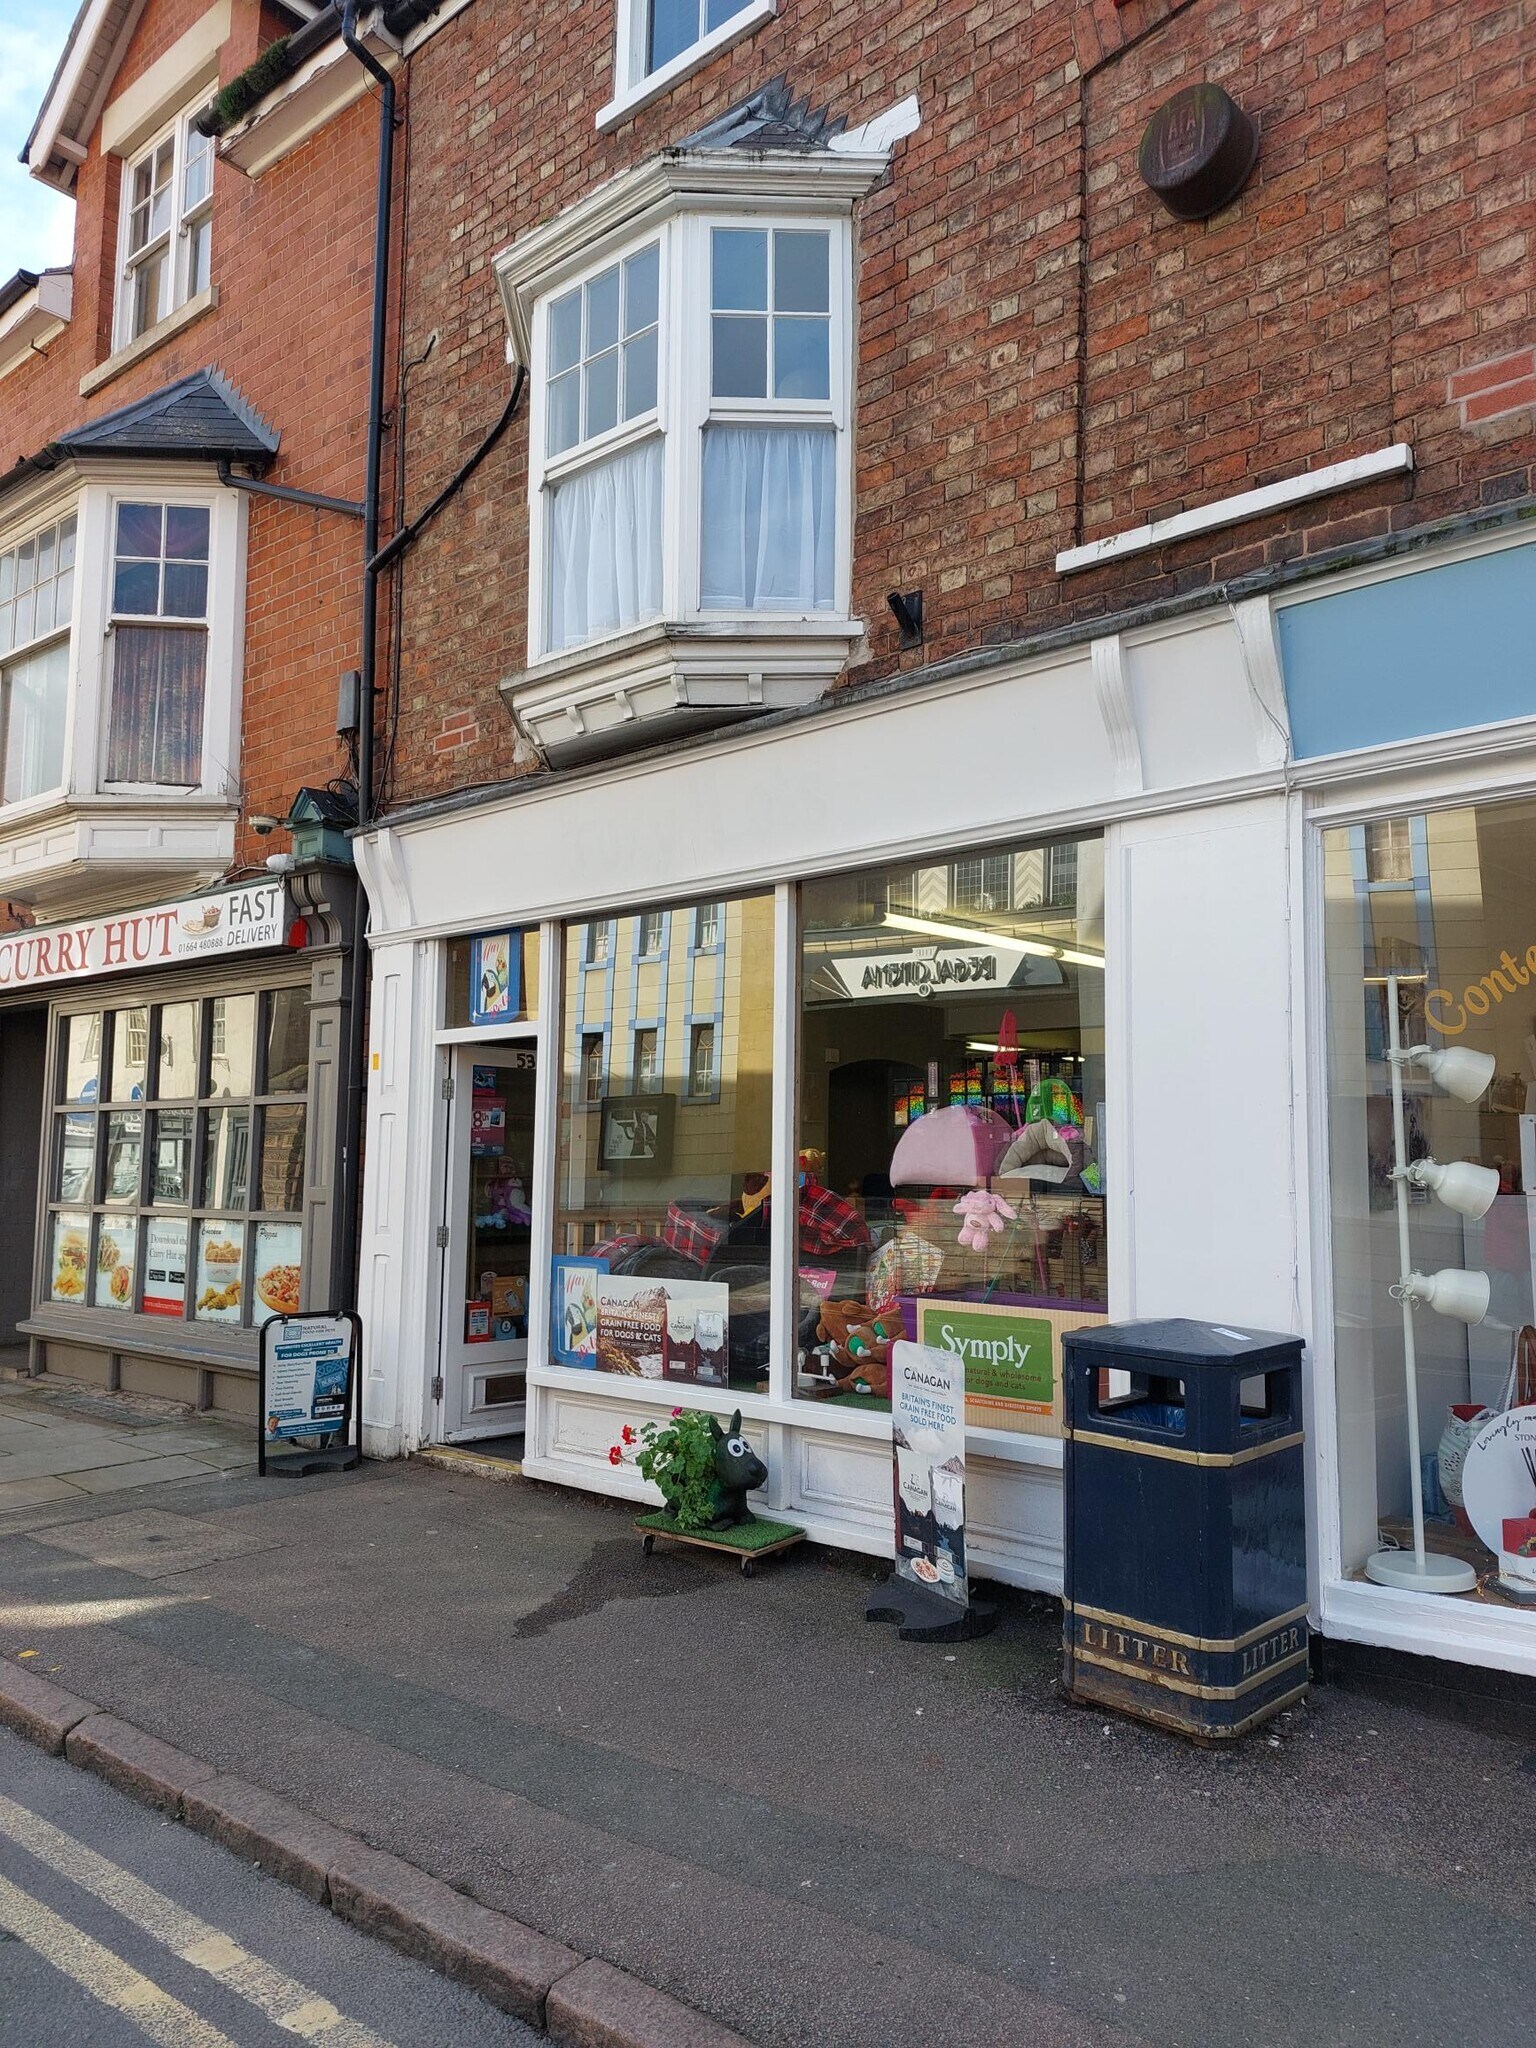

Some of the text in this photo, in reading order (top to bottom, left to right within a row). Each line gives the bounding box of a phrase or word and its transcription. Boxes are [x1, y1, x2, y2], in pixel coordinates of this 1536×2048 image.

[229, 888, 279, 925] FAST
[227, 923, 278, 946] DELIVERY
[0, 909, 178, 983] CURRY HUT
[178, 941, 198, 953] 01664
[516, 1052, 536, 1069] 53
[150, 1233, 178, 1245] Download
[149, 1248, 165, 1261] Curry
[166, 1250, 177, 1259] Hut
[811, 1280, 828, 1289] Red
[600, 1296, 640, 1309] CANAGAN
[600, 1309, 656, 1320] BRITAIN'S FINEST
[600, 1318, 660, 1331] GRAIN FREE FOOD
[600, 1328, 661, 1342] FOR DOGS & CATS
[941, 1324, 1032, 1368] Symply
[904, 1367, 950, 1390] CANAGAN
[965, 1367, 1042, 1382] natural & wholesome
[975, 1377, 993, 1388] dogs
[1010, 1382, 1026, 1390] cats
[901, 1392, 954, 1414] BRITAIN'S FINEST
[900, 1402, 957, 1425] GRAIN FREE FOOD
[910, 1414, 945, 1432] SOLD HERE
[1476, 1415, 1520, 1451] Lovingly
[903, 1481, 928, 1496] CANAGAN
[935, 1498, 956, 1512] CANAGAN
[1083, 1622, 1190, 1676] LITTER
[1242, 1627, 1299, 1675] LITTER
